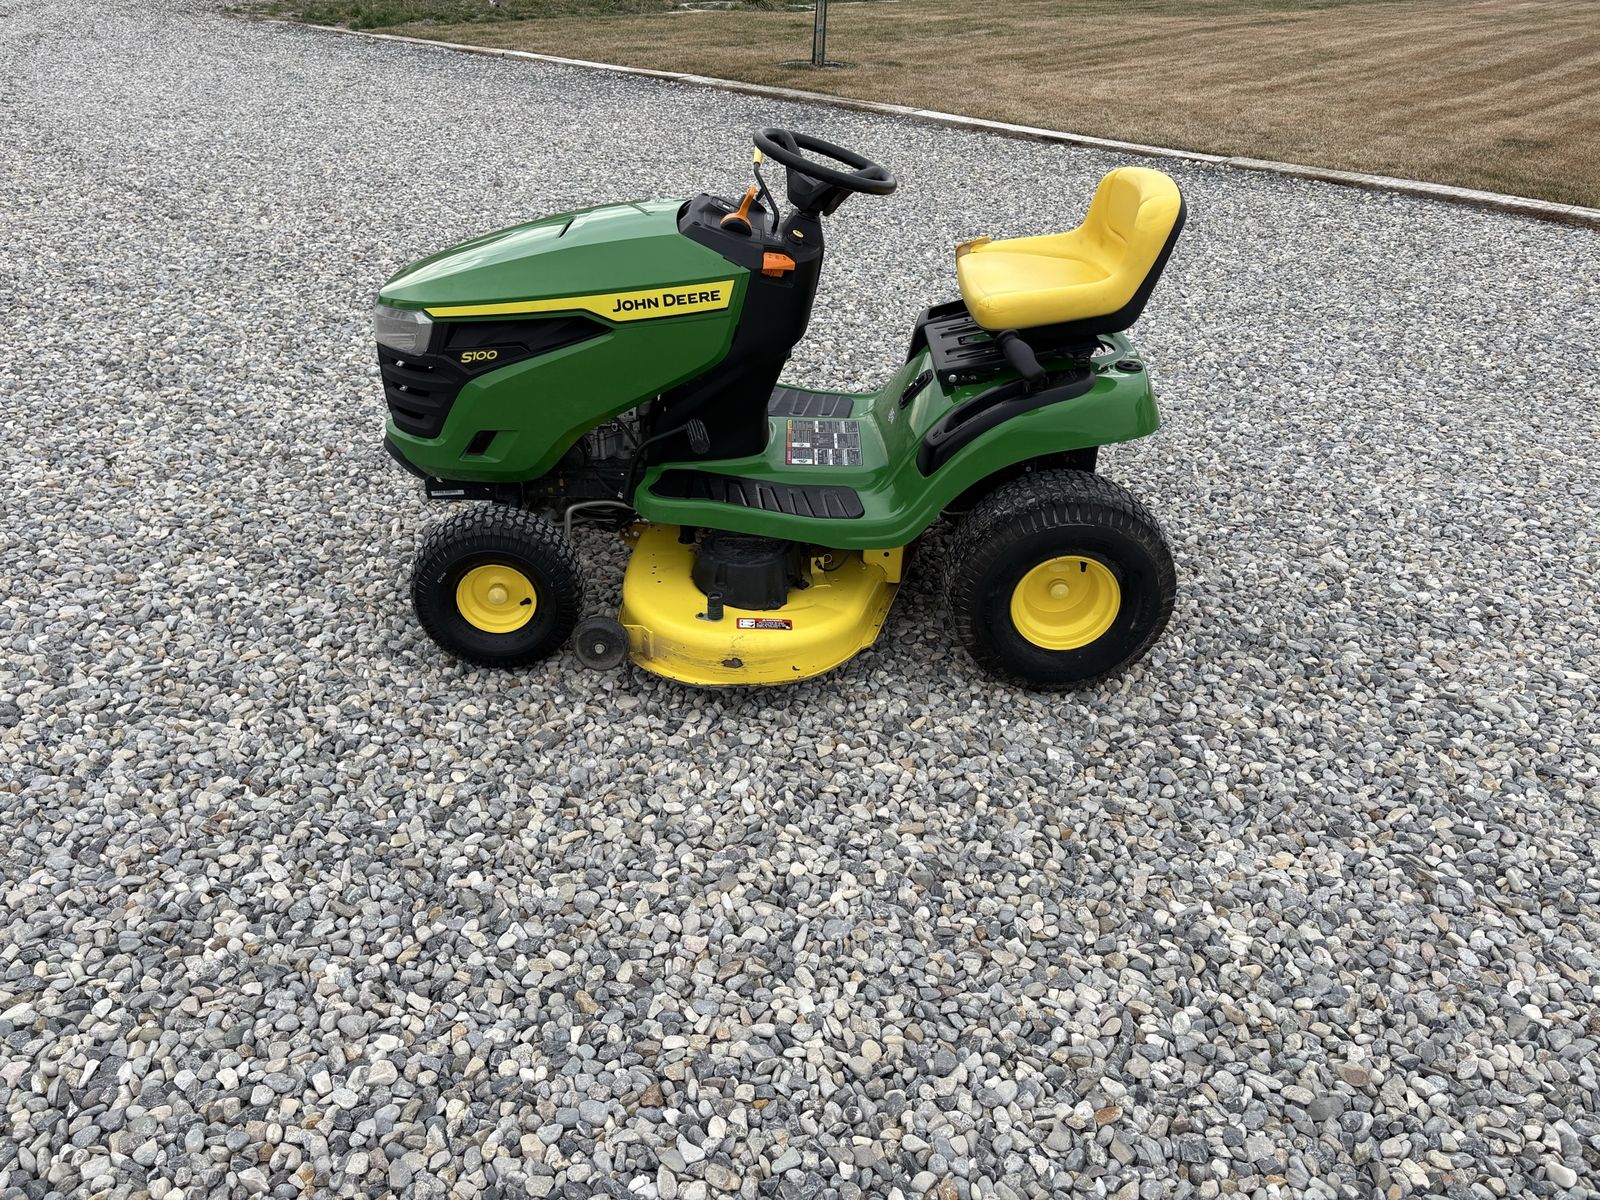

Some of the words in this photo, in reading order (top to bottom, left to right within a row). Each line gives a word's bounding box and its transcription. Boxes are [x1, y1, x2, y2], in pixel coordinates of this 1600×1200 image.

[612, 297, 659, 313] JOHN
[662, 290, 721, 307] DEERE
[460, 350, 498, 363] S100
